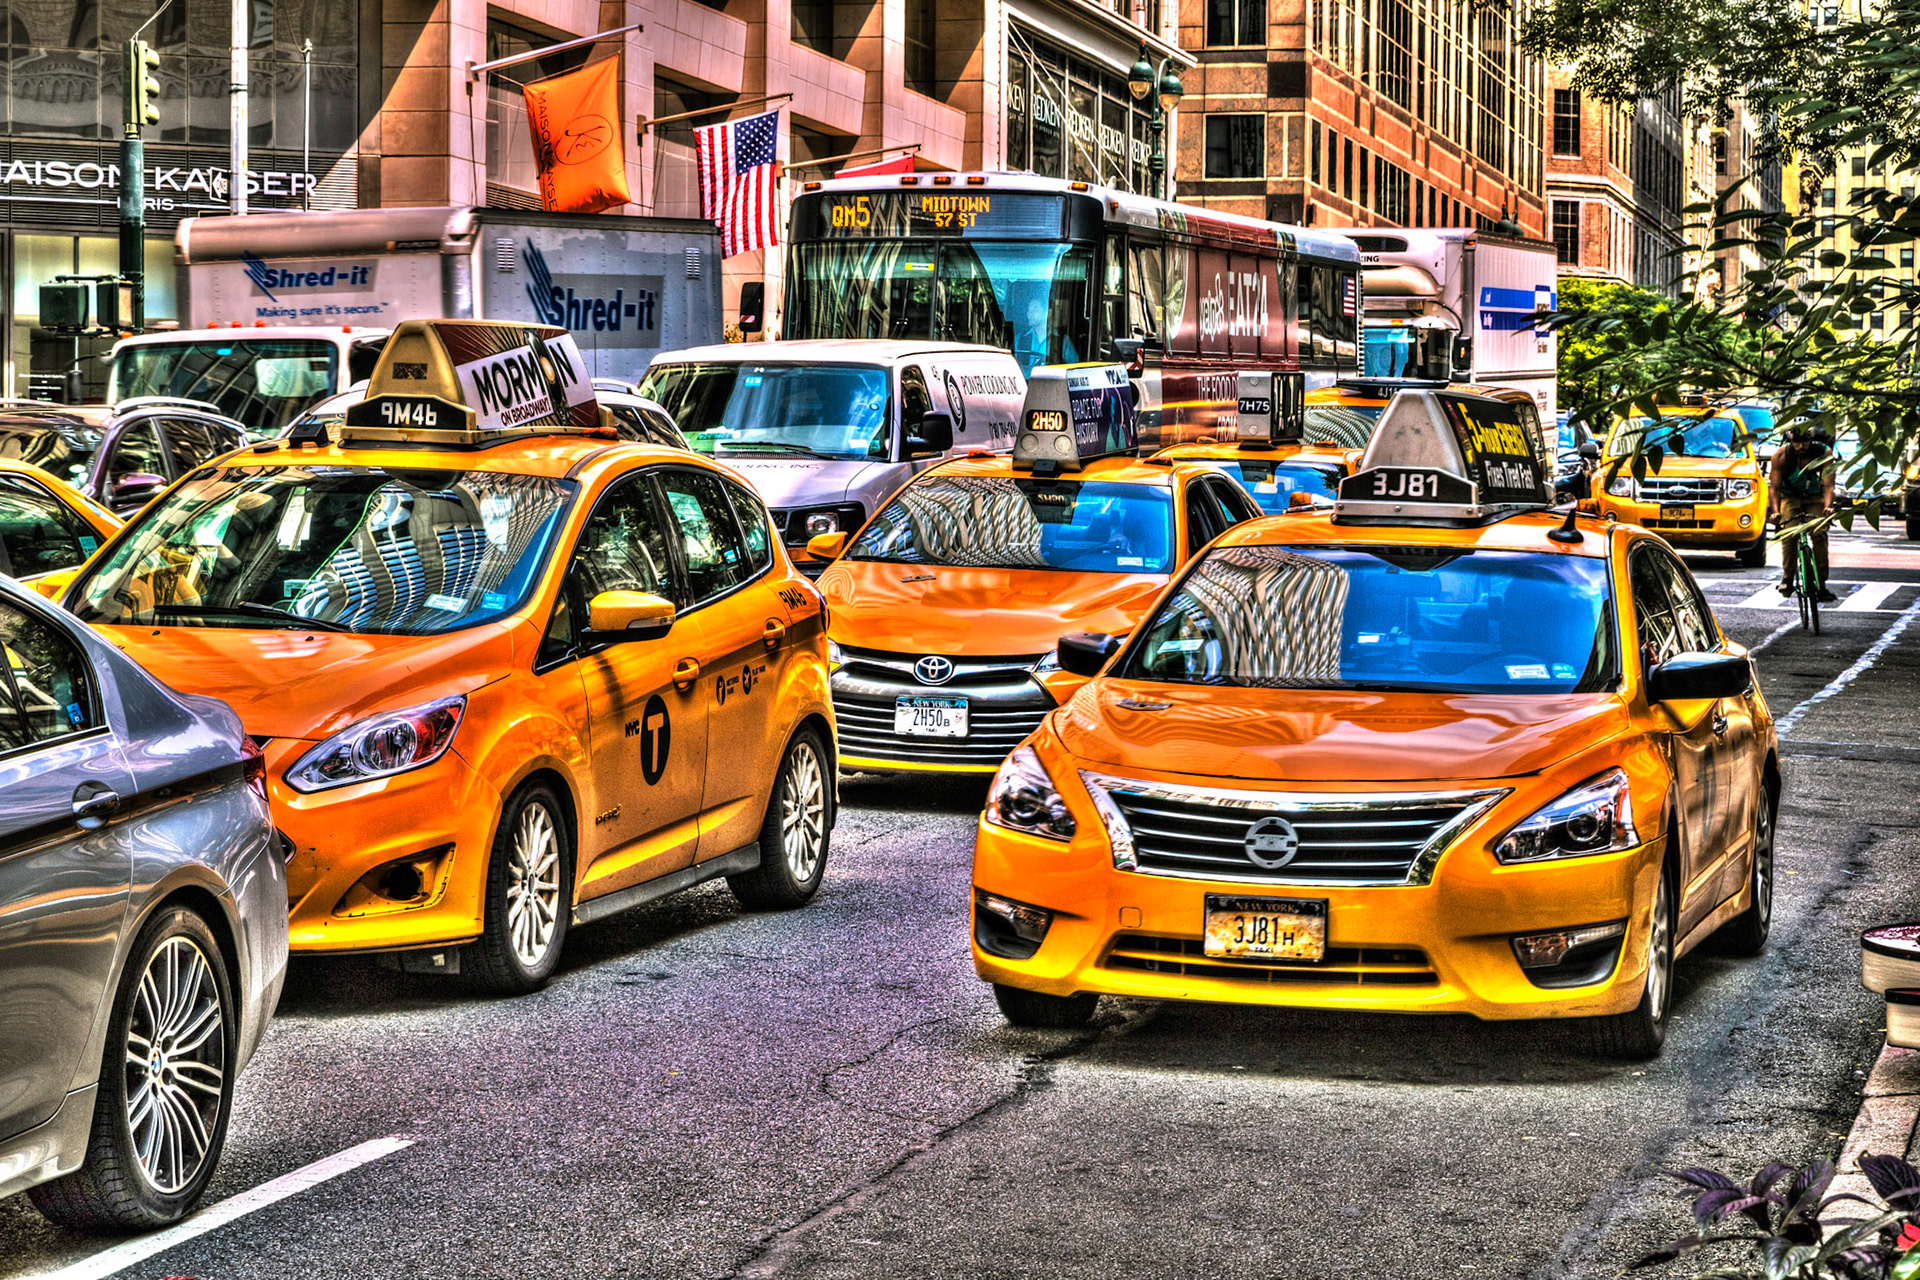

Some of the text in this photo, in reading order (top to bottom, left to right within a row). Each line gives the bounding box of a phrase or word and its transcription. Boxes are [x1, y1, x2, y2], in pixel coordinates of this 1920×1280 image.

[538, 91, 557, 211] MAISON KAYSE
[1101, 123, 1125, 156] REDKEN
[1133, 137, 1152, 167] REDKE
[0, 160, 317, 196] AISON KASER
[216, 178, 227, 192] ONE
[117, 197, 174, 211] RIS
[832, 196, 871, 228] QM5
[922, 196, 990, 213] MIDTOWN
[935, 213, 977, 228] 57 ST
[263, 265, 369, 288] Shred-it
[256, 305, 383, 319] Making sure it's secure.
[548, 285, 656, 332] Shred-it
[1228, 271, 1269, 337] EAT24
[961, 375, 985, 395] POWER
[1197, 376, 1211, 402] THE
[1211, 376, 1231, 402] FOOD
[381, 402, 437, 426] 9M46
[500, 397, 552, 427] ON BROADWAY!
[1072, 397, 1103, 420] BRACE FOR
[1239, 400, 1270, 412] 7H75
[1032, 411, 1062, 430] 2H50
[1217, 415, 1237, 442] FROM
[1457, 402, 1530, 457] 5-hour ENERGY
[1075, 422, 1098, 444] HISTORY
[1373, 472, 1438, 497] 3J81
[1484, 460, 1536, 490] Fixes Tired Fast
[778, 587, 807, 610] 9M46
[912, 700, 950, 709] NEW YORK
[624, 720, 640, 738] NYC
[913, 708, 950, 727] 2H50B
[1235, 902, 1296, 913] NEW YORK
[1234, 915, 1295, 946] 3J81H
